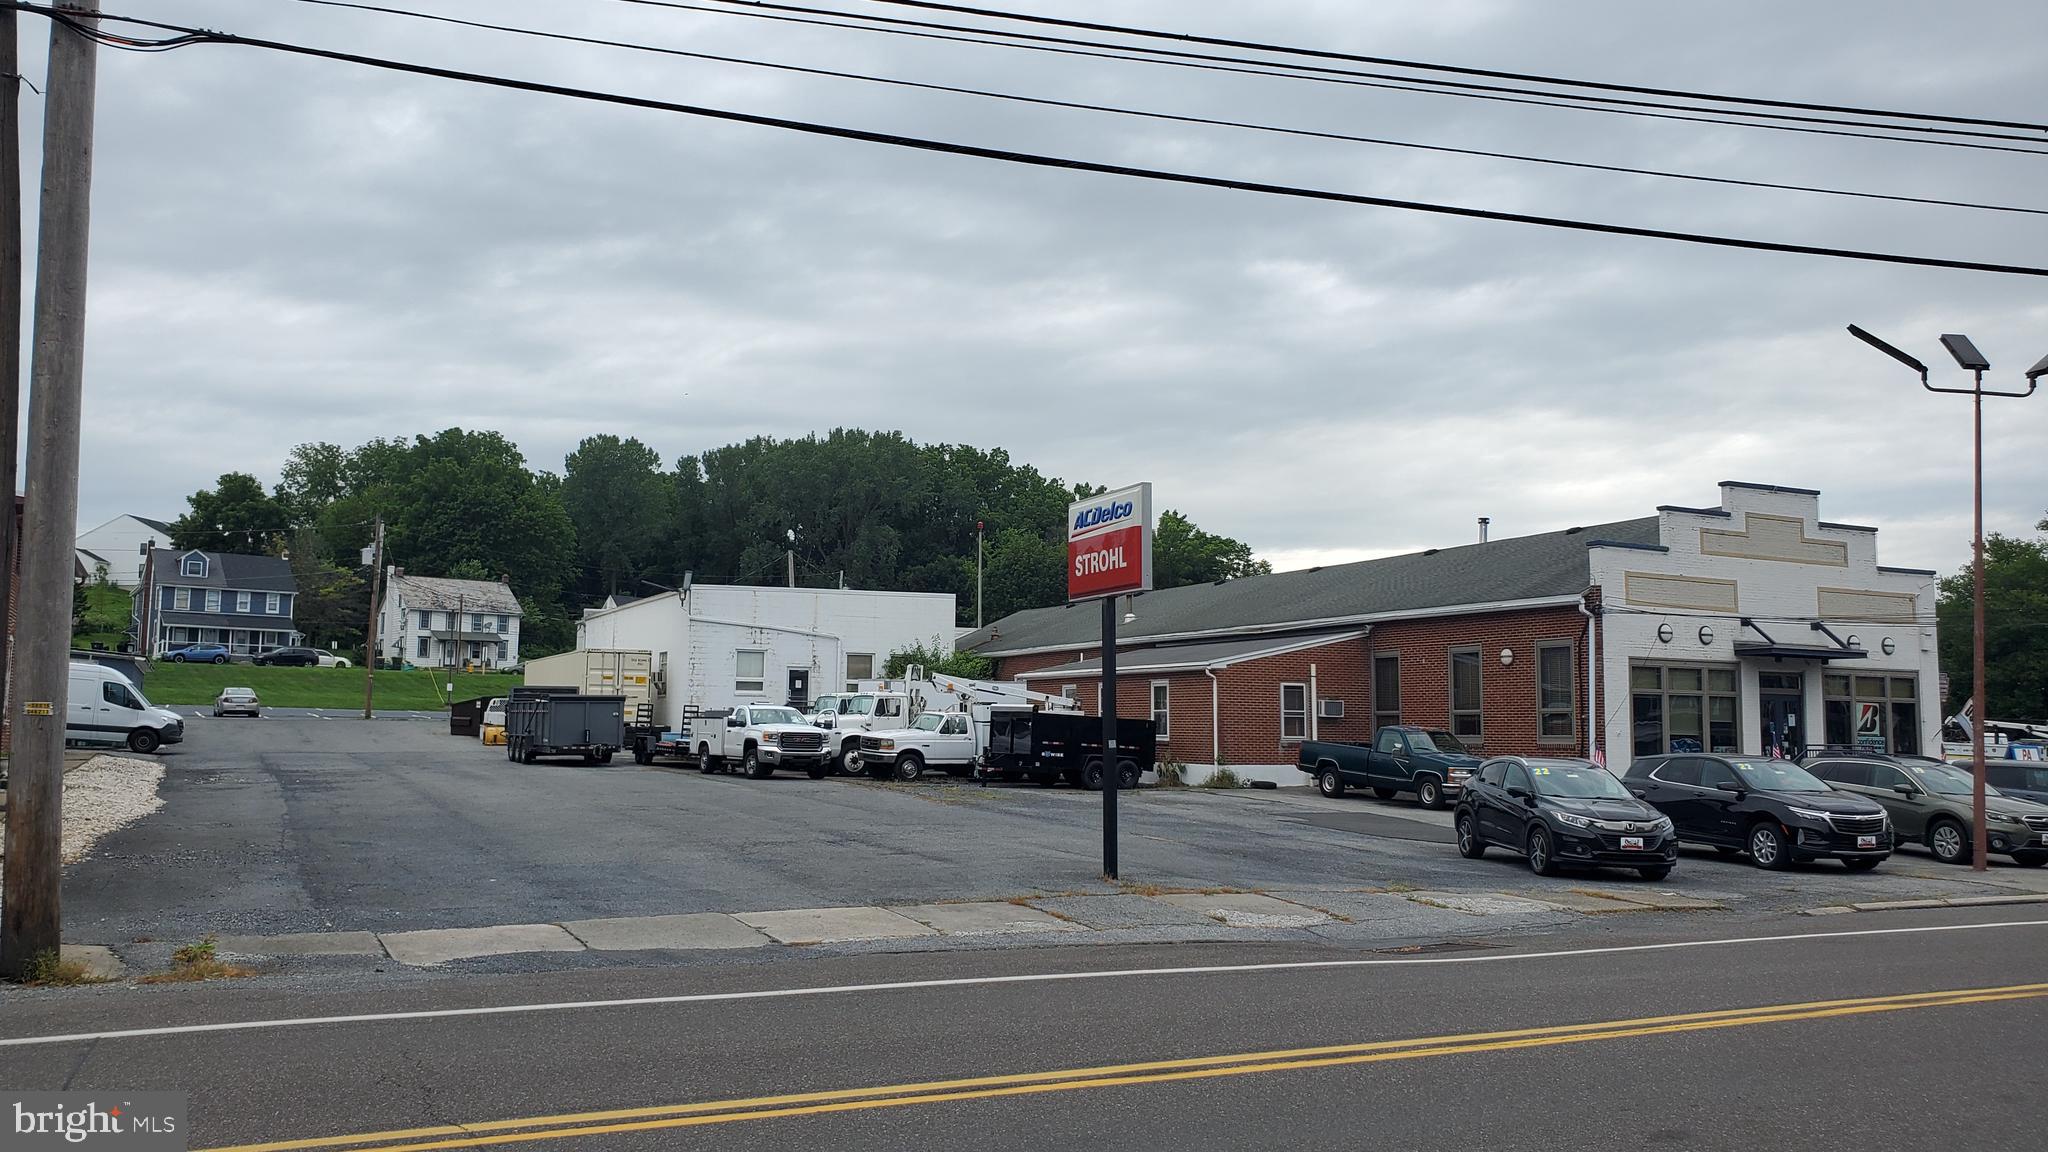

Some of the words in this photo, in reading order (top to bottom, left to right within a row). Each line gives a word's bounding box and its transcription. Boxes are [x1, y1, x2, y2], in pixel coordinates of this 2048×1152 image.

[1073, 500, 1133, 530] ACDelco
[1075, 546, 1127, 577] STROHL
[2022, 749, 2032, 760] PA
[1533, 767, 1550, 775] 22
